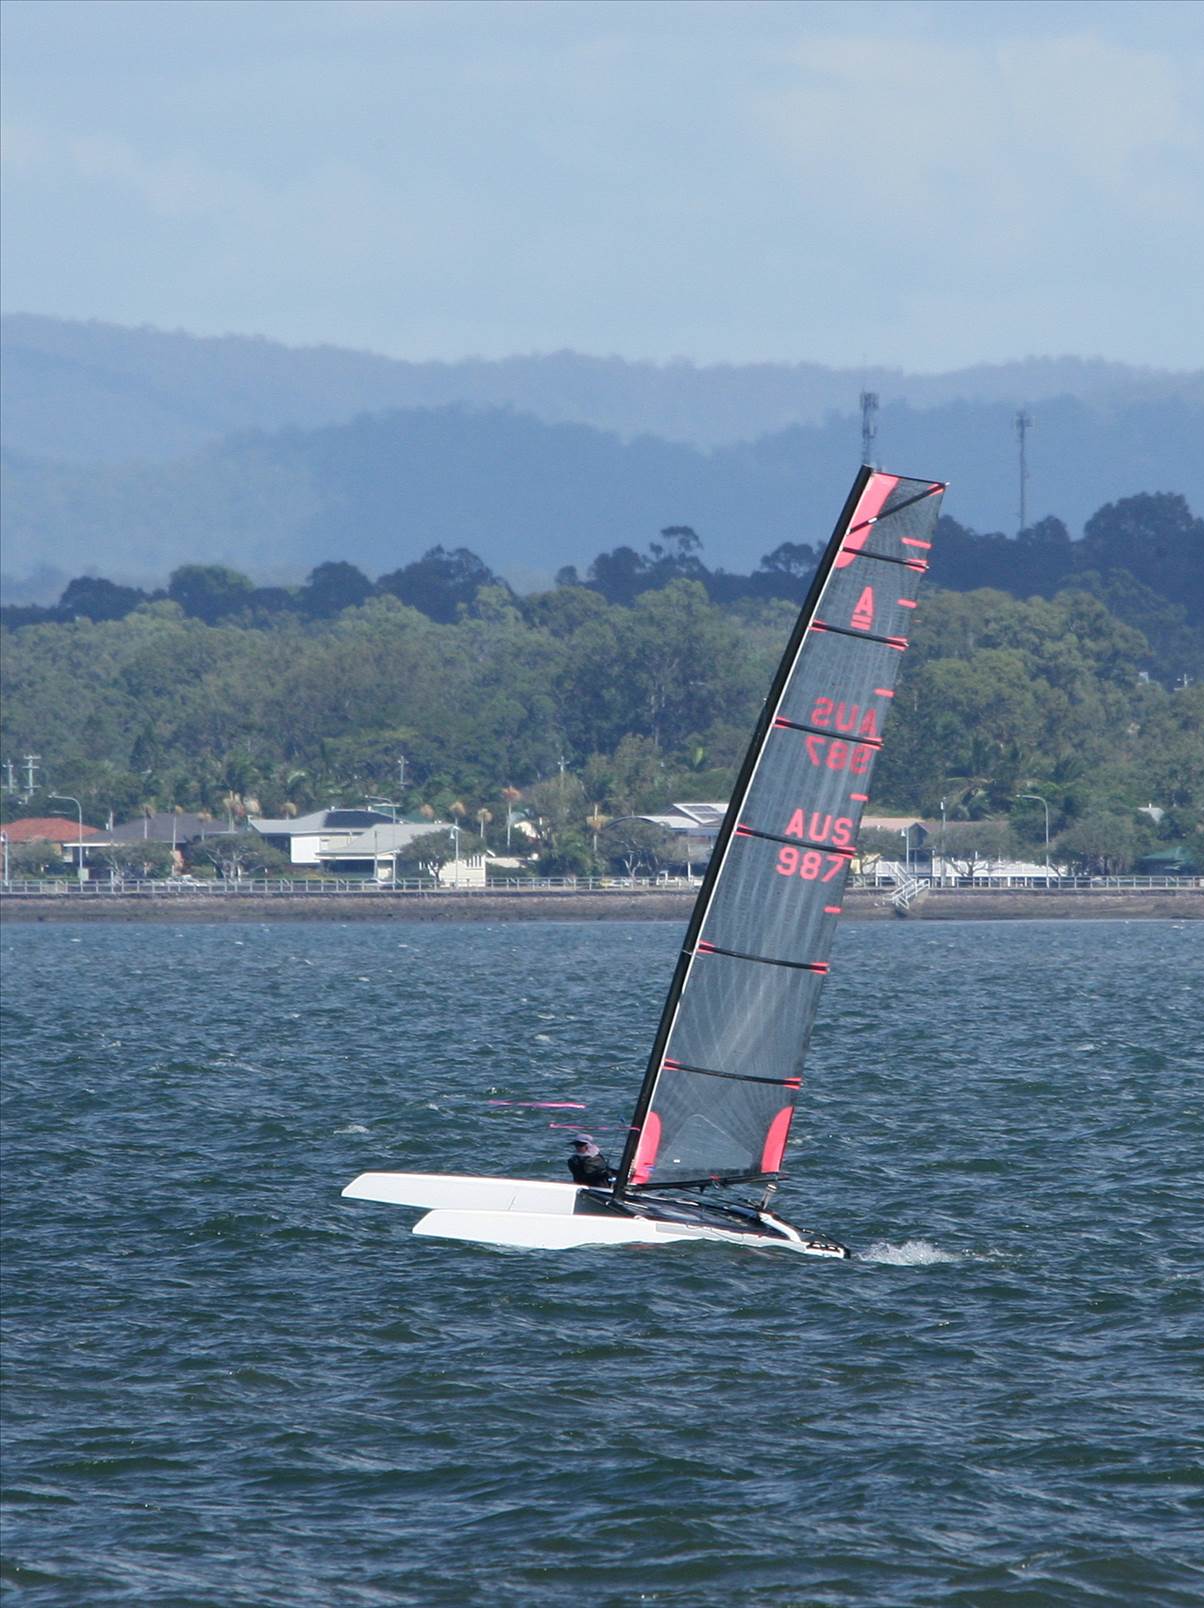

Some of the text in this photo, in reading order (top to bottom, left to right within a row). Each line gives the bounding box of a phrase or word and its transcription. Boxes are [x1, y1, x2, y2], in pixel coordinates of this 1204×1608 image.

[855, 586, 875, 617] A
[784, 808, 853, 846] AUS
[776, 846, 844, 882] 987
